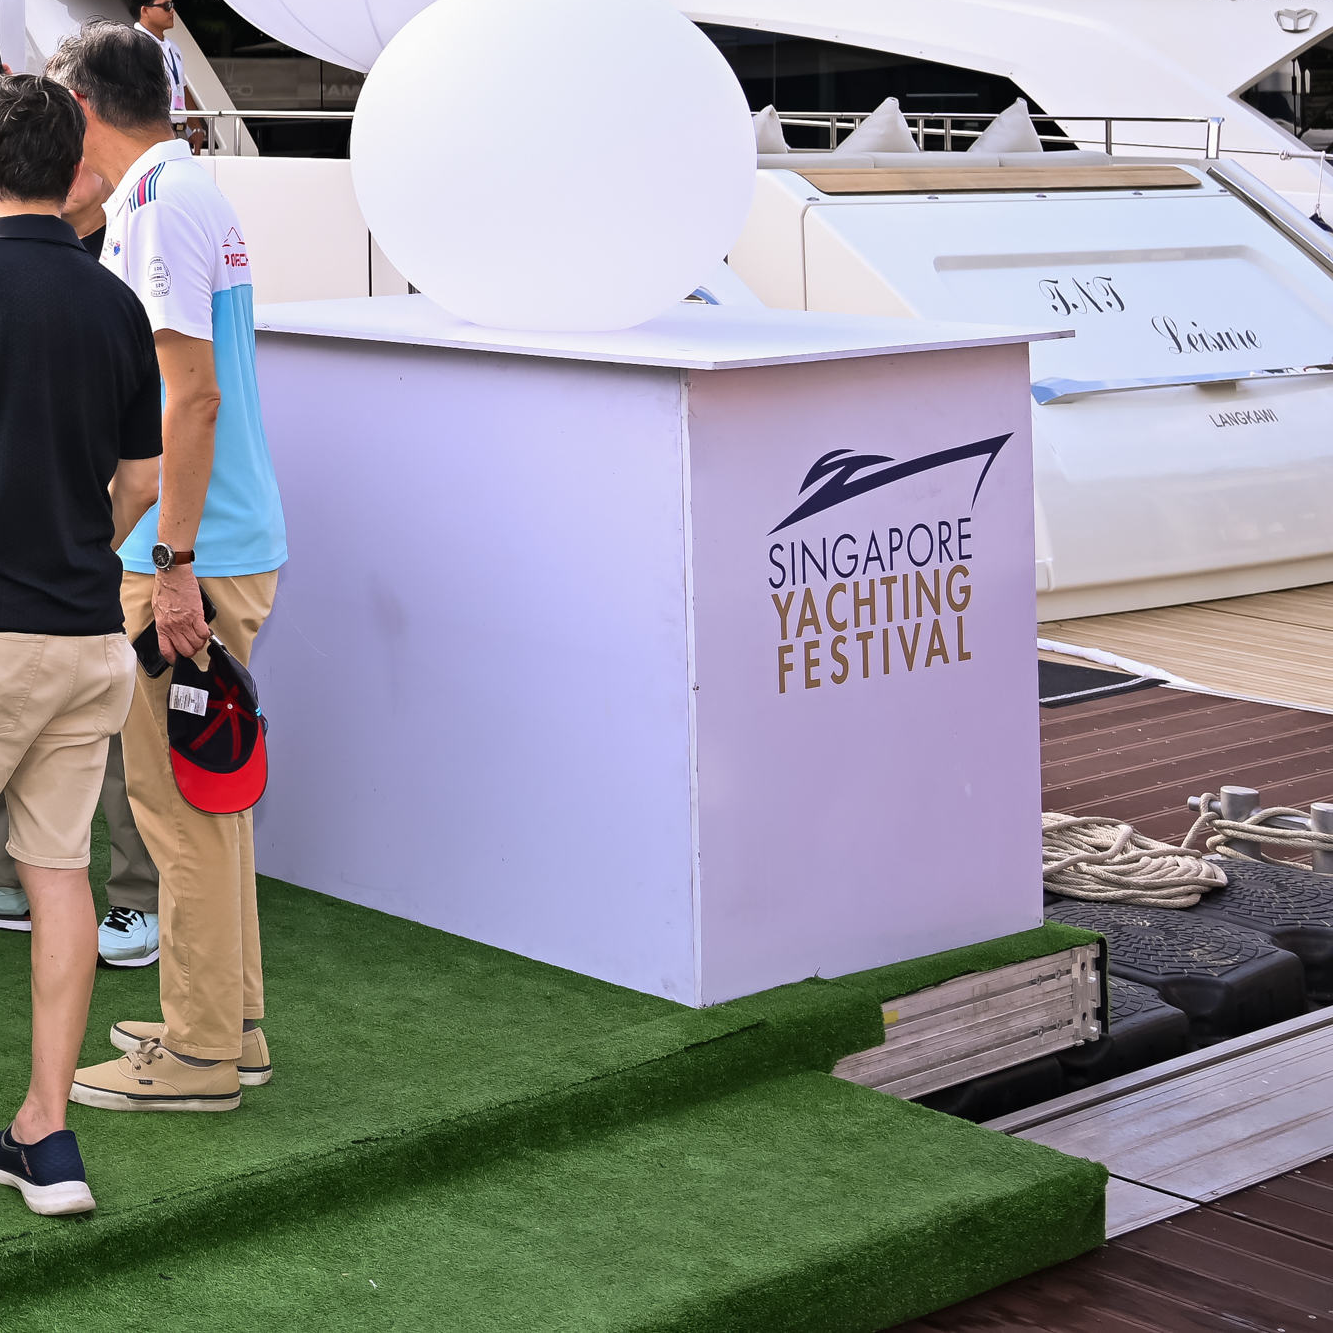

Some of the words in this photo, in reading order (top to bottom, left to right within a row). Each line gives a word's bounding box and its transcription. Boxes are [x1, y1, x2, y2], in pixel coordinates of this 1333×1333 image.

[1151, 316, 1262, 354] Leisure
[1208, 409, 1279, 428] LANGKAWI
[768, 517, 972, 589] SINGAPORE
[771, 564, 971, 640] YACHTING
[777, 616, 971, 694] FESTIVAL
